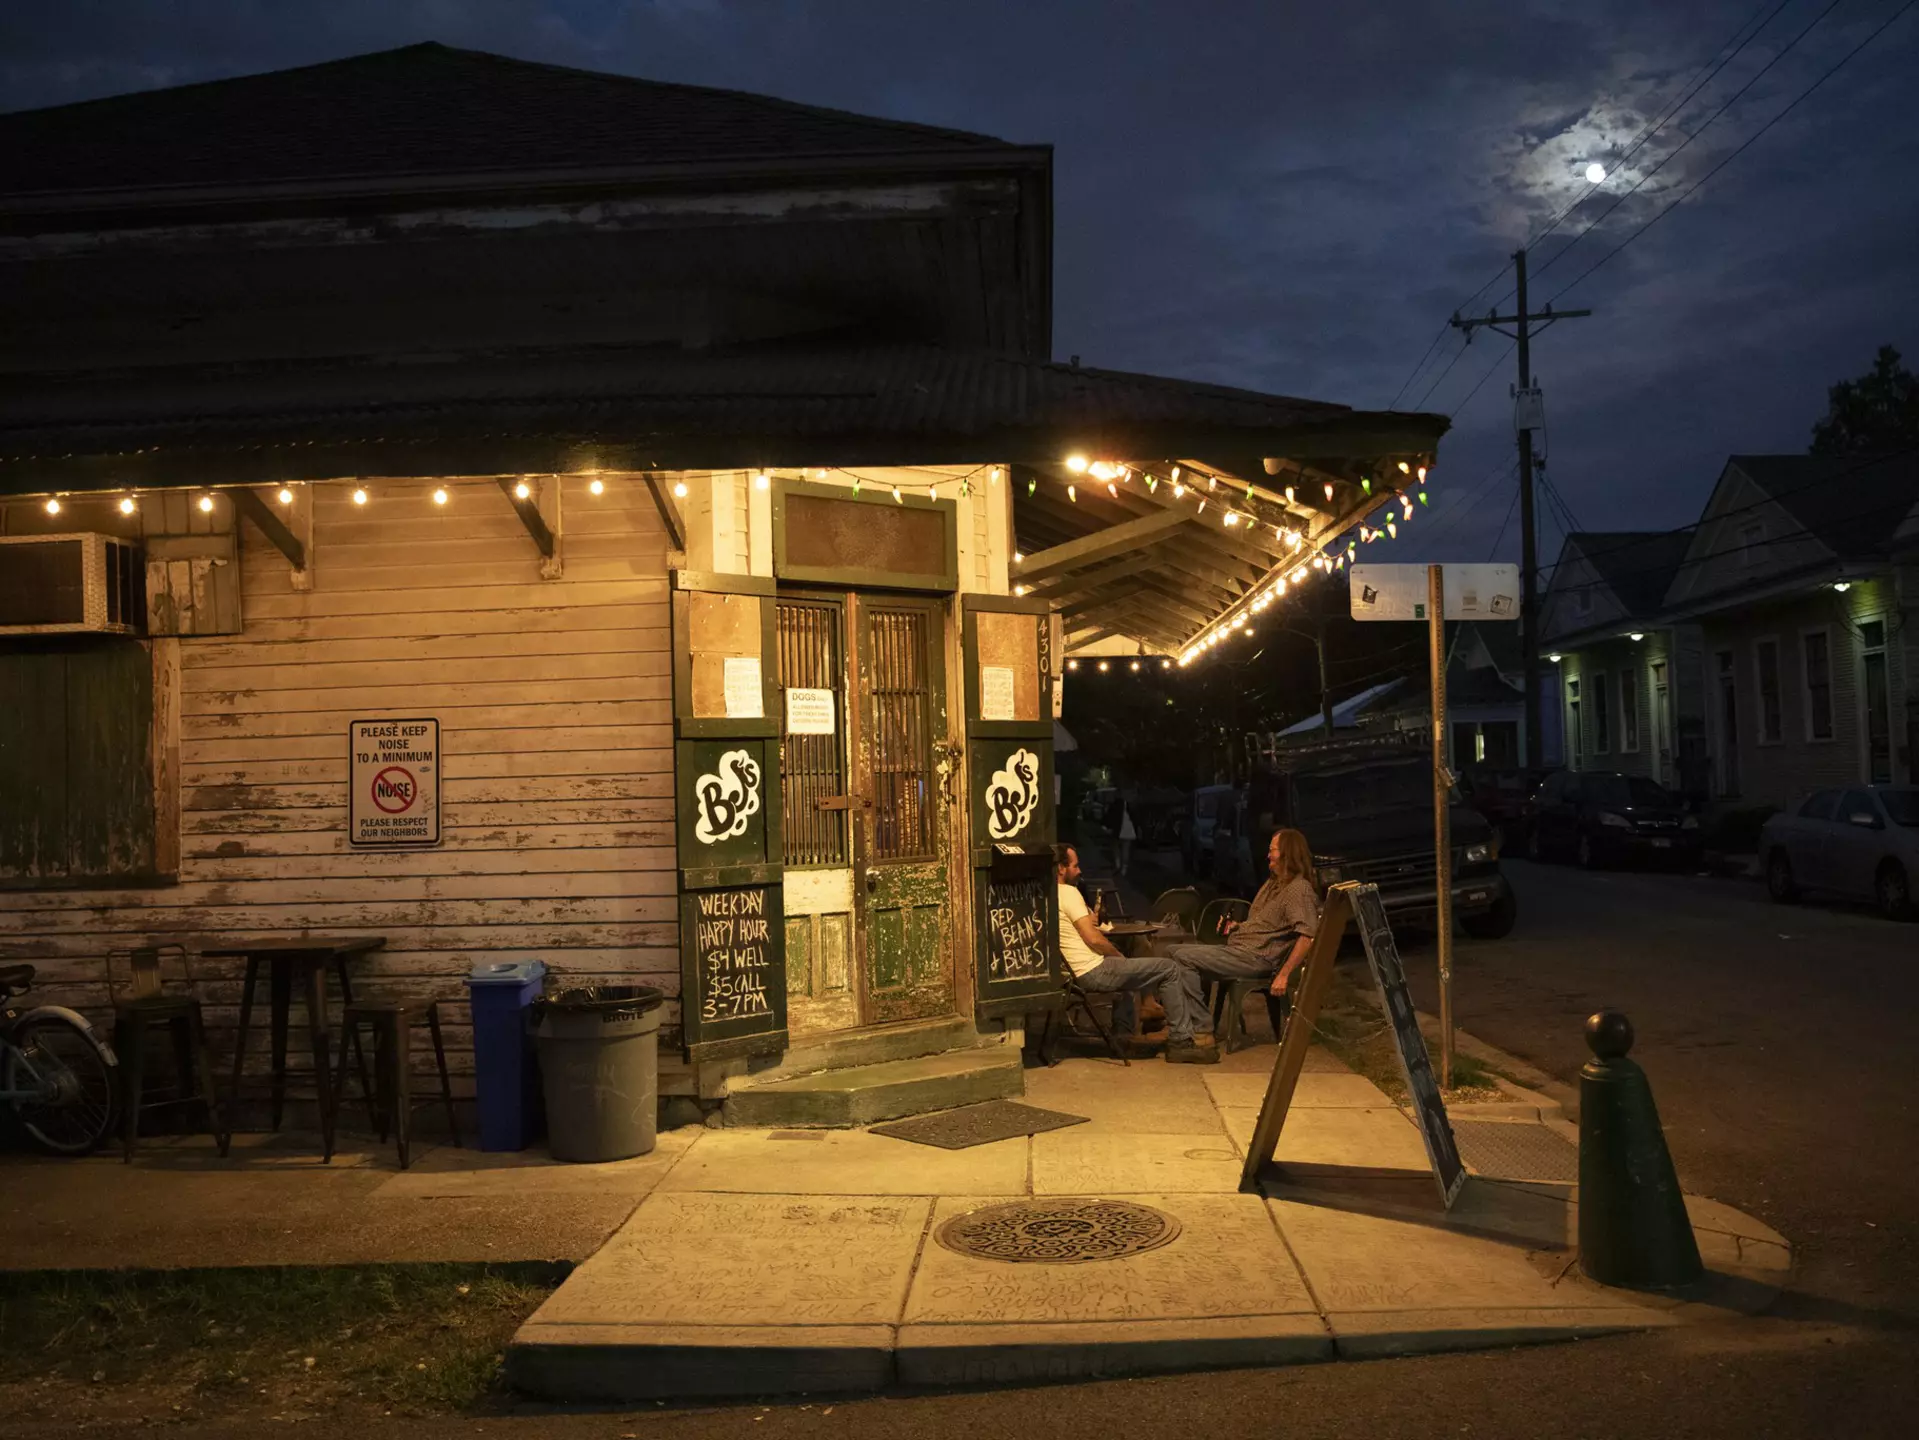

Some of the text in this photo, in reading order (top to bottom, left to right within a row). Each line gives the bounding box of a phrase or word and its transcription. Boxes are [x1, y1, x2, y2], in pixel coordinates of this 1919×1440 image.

[792, 692, 816, 701] DOGS
[360, 726, 428, 737] PLEASE KEEP
[378, 739, 410, 750] NOISE
[356, 751, 433, 763] TO A MINIMUM
[377, 782, 411, 798] NOISE
[360, 817, 428, 827] PLEASE RESPECT
[360, 827, 428, 837] OUR NEIGHBORS
[990, 908, 1014, 932] RED
[699, 919, 769, 952] HAPPY HOUR
[1000, 910, 1043, 947] BEANS
[707, 945, 770, 973] $4 WELL
[1003, 941, 1045, 973] BLUES
[708, 973, 767, 998] $5 CALL
[602, 1011, 645, 1023] BRUTE
